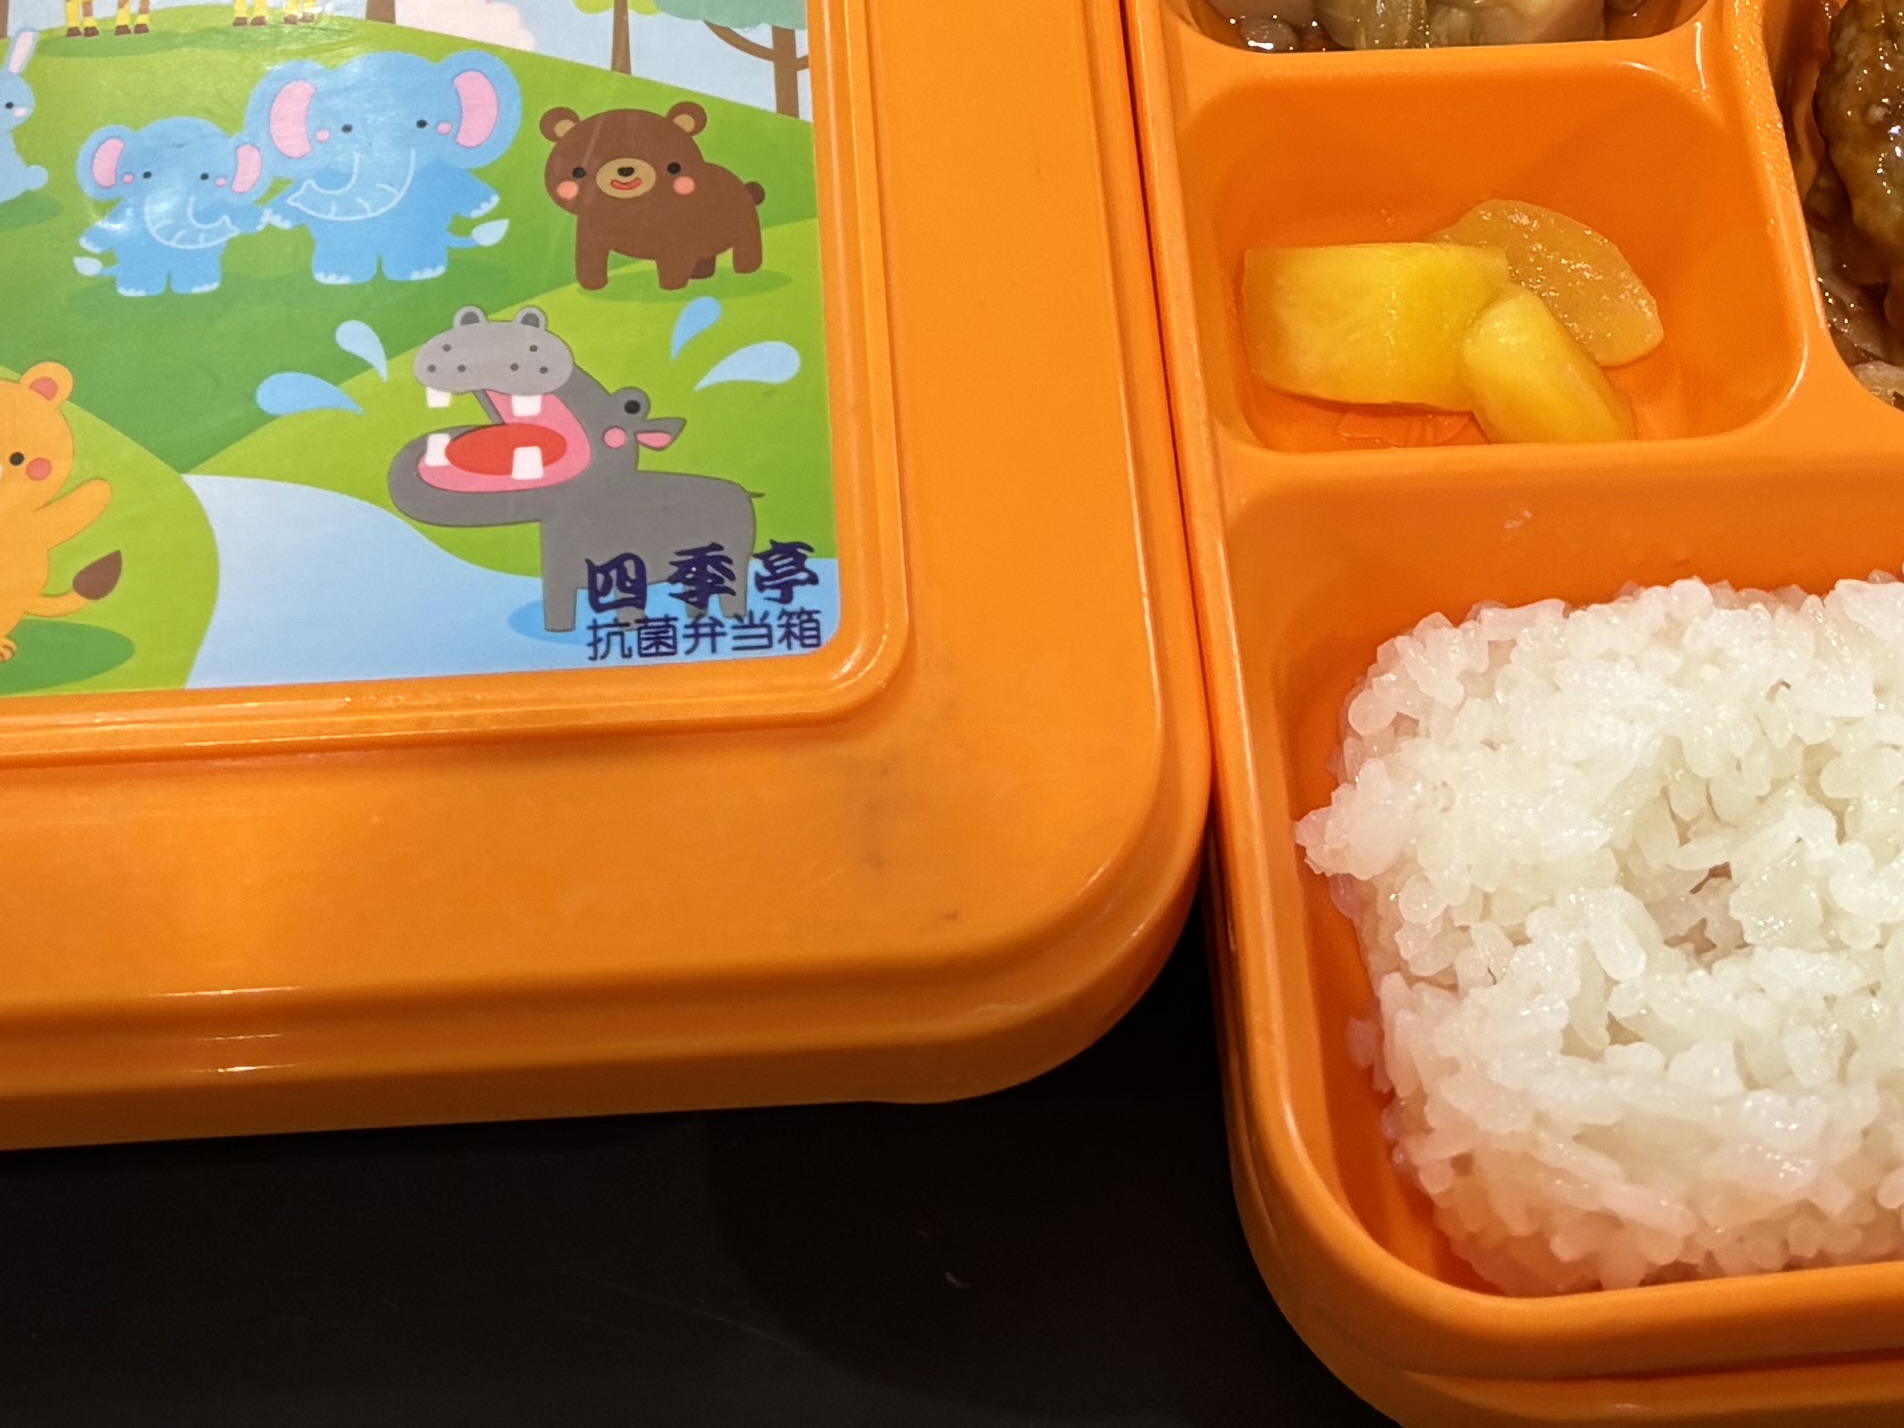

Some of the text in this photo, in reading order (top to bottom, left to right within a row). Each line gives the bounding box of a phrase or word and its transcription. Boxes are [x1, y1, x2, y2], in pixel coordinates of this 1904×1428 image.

[584, 538, 821, 614] 四季亭
[586, 606, 823, 662] 抗菌弁当箱
